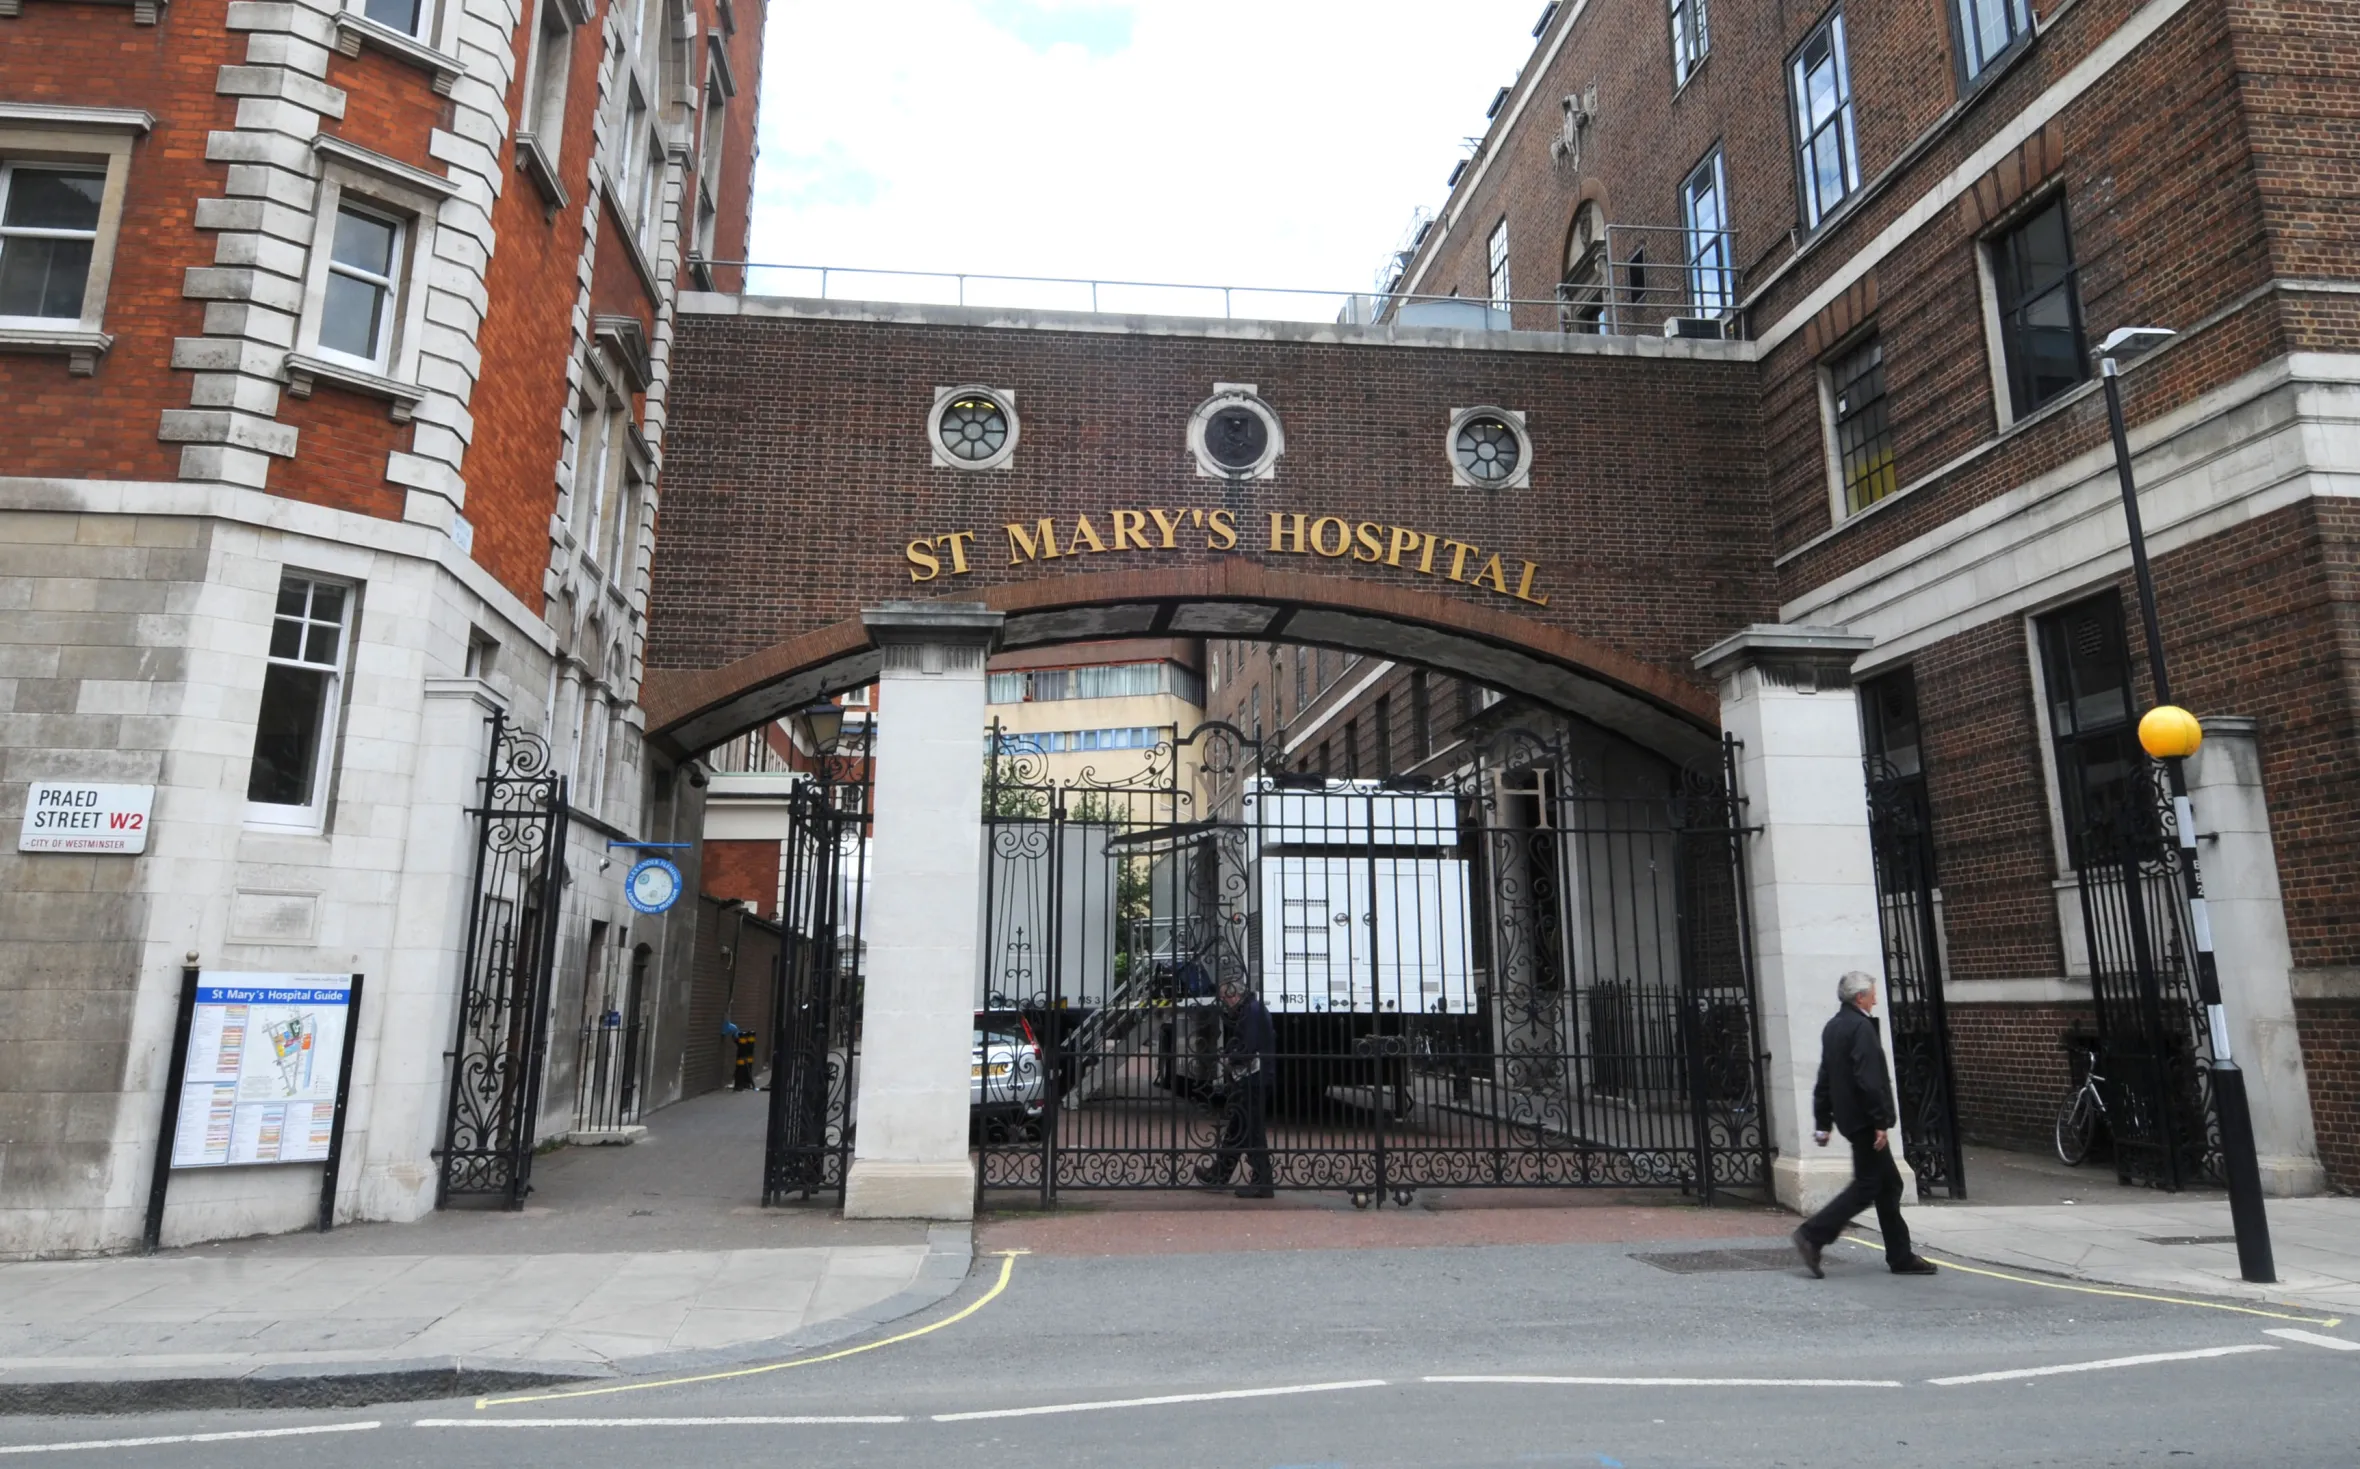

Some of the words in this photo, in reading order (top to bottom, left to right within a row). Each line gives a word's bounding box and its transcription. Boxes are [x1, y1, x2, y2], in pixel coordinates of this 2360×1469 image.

[905, 529, 974, 583] ST
[1002, 508, 1238, 565] MARY'S
[1265, 511, 1550, 607] HOSPITAL
[39, 789, 98, 807] PRAED
[34, 811, 103, 828] STREET
[110, 812, 144, 830] W2
[30, 839, 49, 847] CITY
[52, 840, 62, 848] OF
[65, 840, 125, 849] WESTMINSTER
[212, 988, 223, 999] St
[227, 989, 265, 1001] Mary's
[268, 989, 311, 1002] Hospital
[313, 990, 343, 1001] Guide
